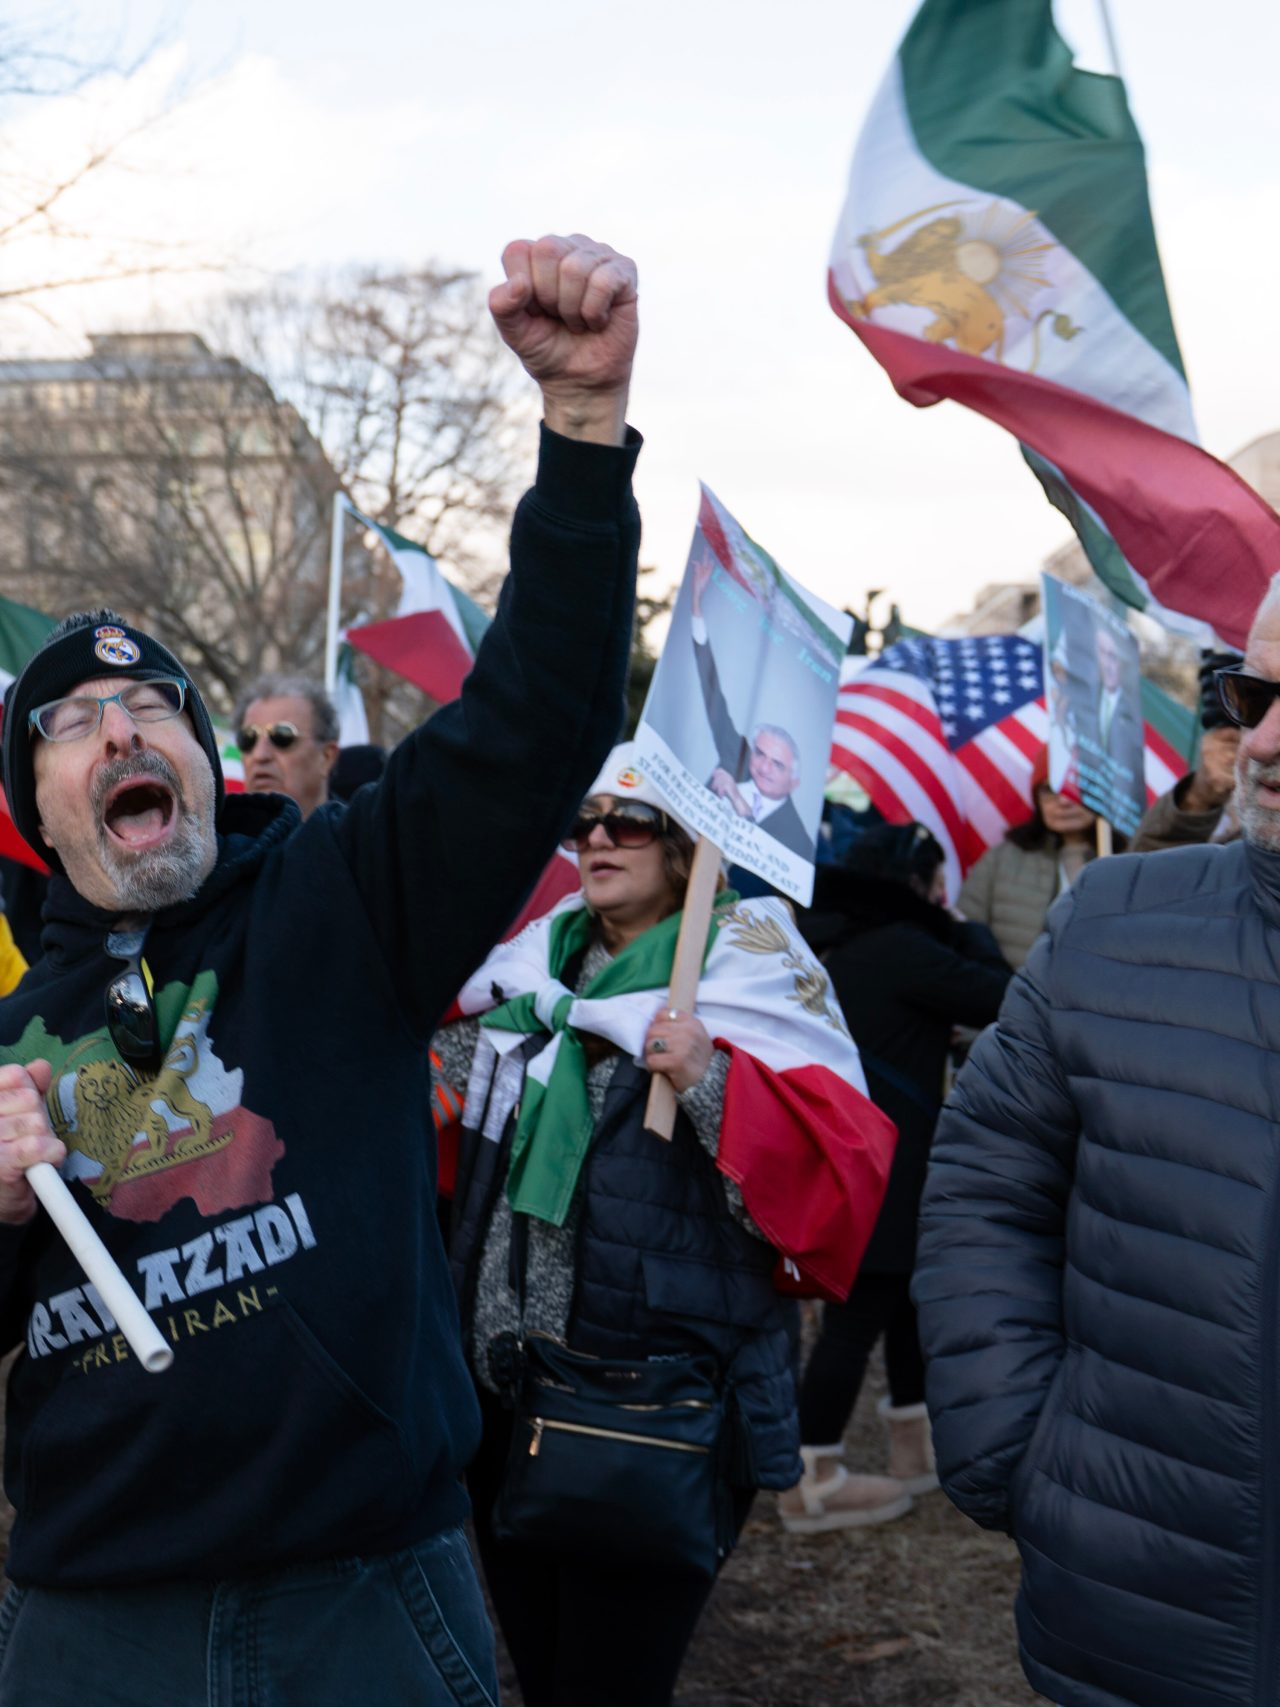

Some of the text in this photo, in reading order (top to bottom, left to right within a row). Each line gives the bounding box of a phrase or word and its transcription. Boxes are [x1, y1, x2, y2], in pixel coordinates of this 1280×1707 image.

[670, 772, 719, 822] FREEDOM
[766, 852, 792, 875] AND
[696, 816, 719, 839] THE
[770, 869, 802, 894] EAST
[136, 1191, 318, 1312] AZADI
